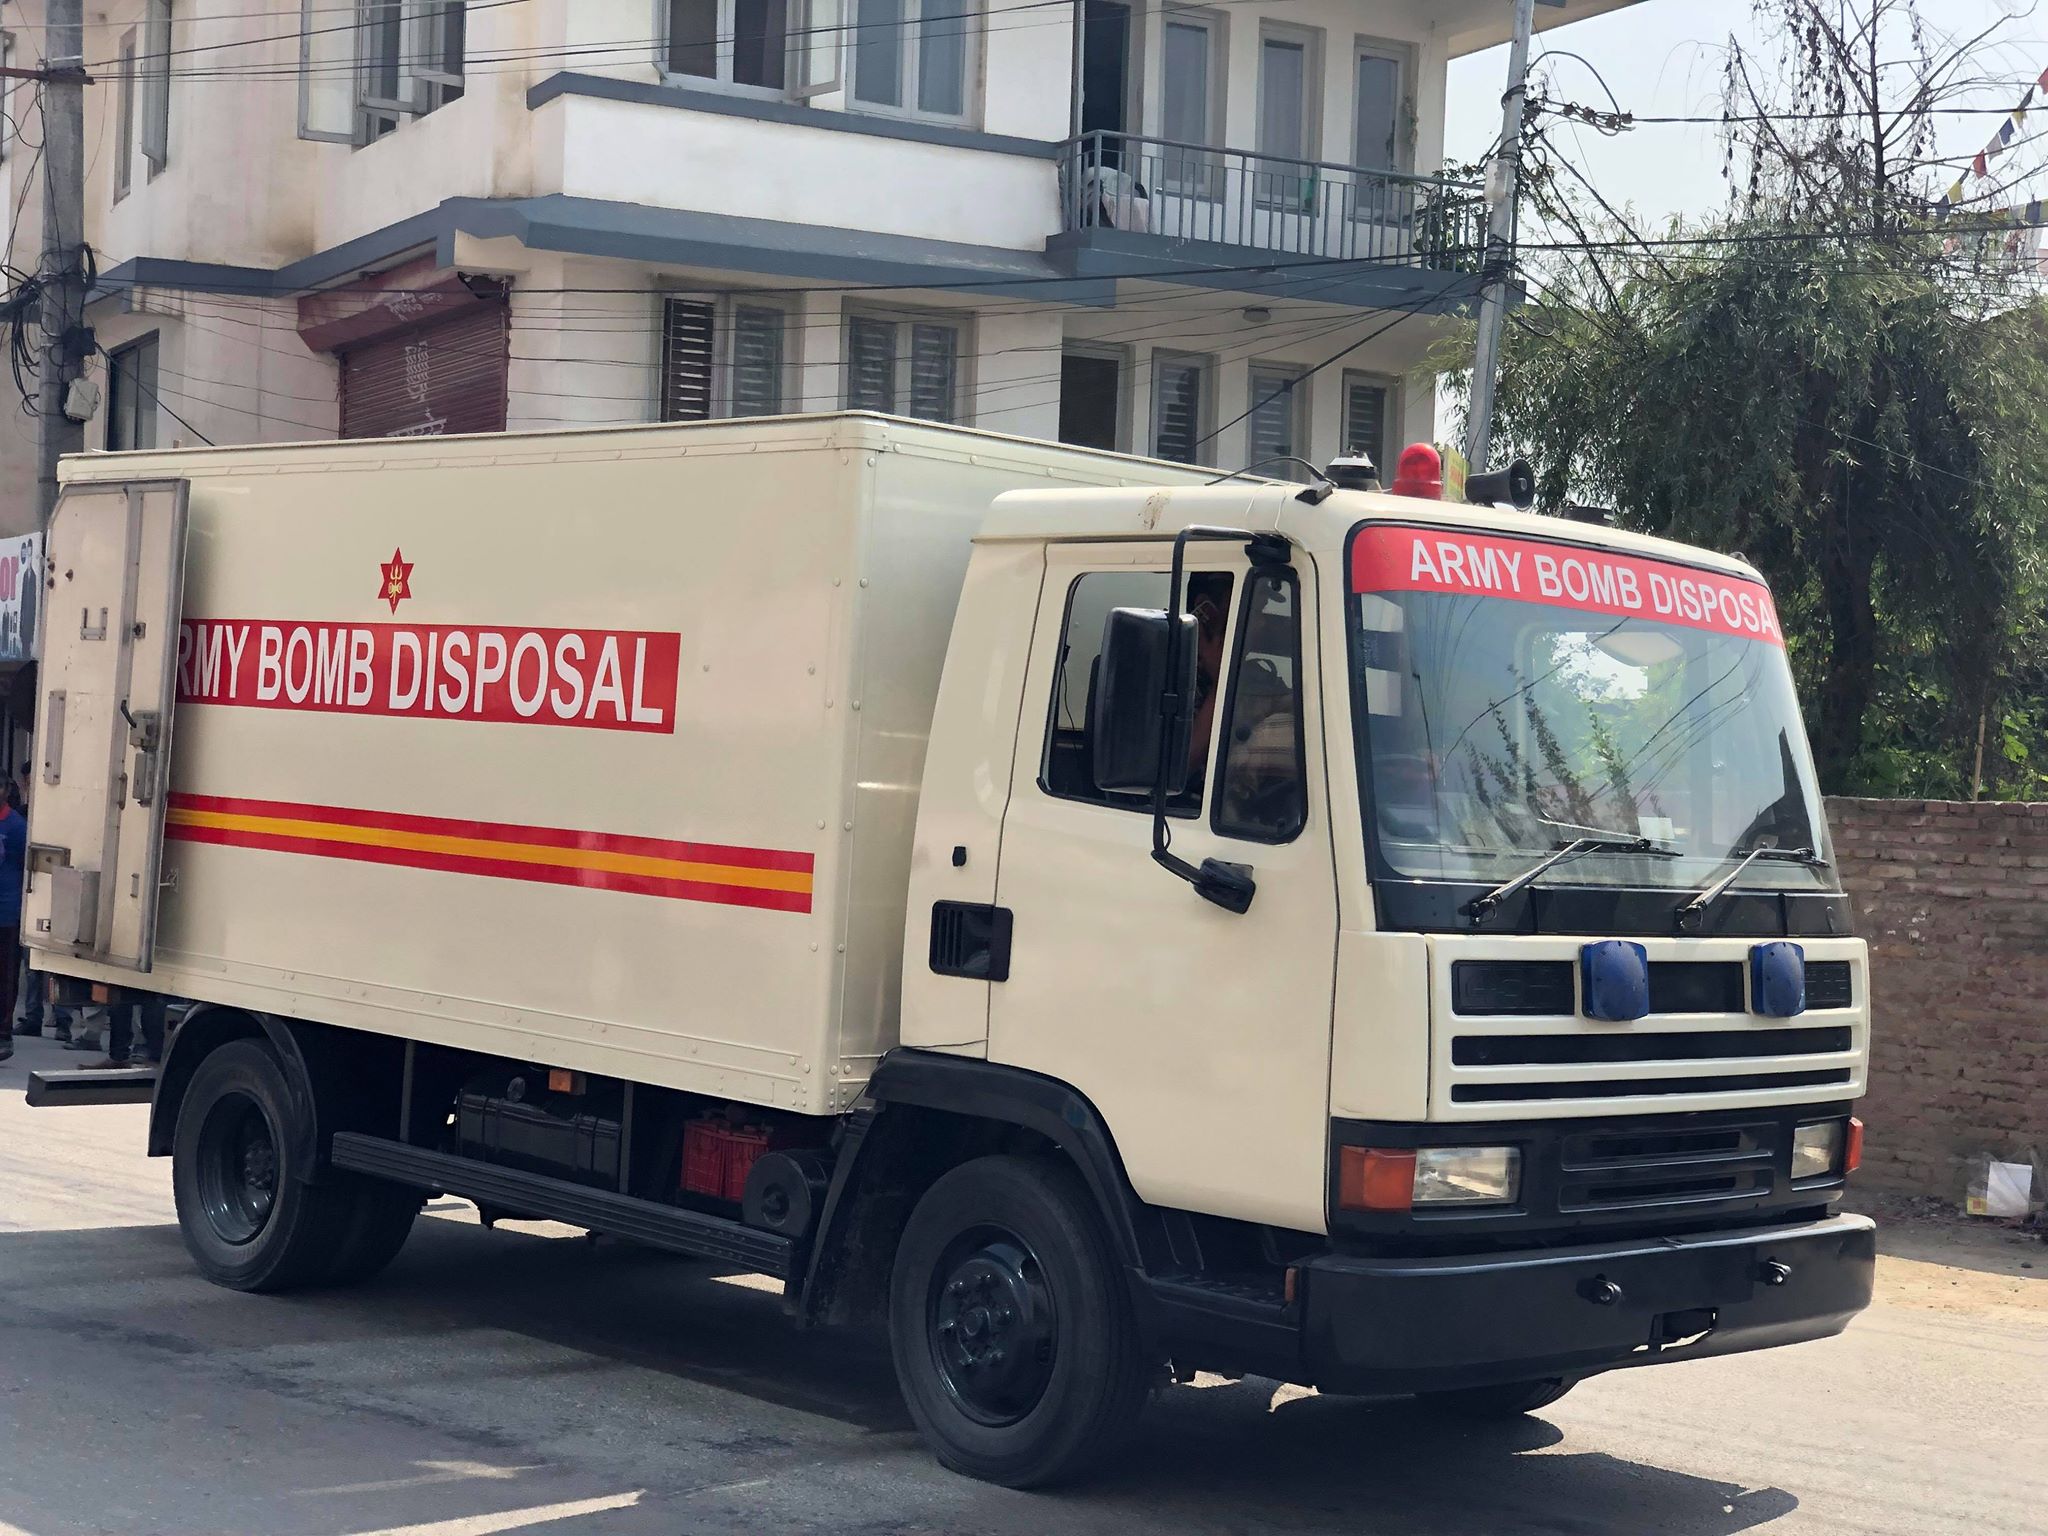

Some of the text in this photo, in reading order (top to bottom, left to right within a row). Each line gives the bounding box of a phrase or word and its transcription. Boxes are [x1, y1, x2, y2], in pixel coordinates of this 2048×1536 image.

[1410, 539, 1782, 641] ARMY BOMB DISPOSA
[178, 624, 664, 724] RMY BOMB DISPOSAL
